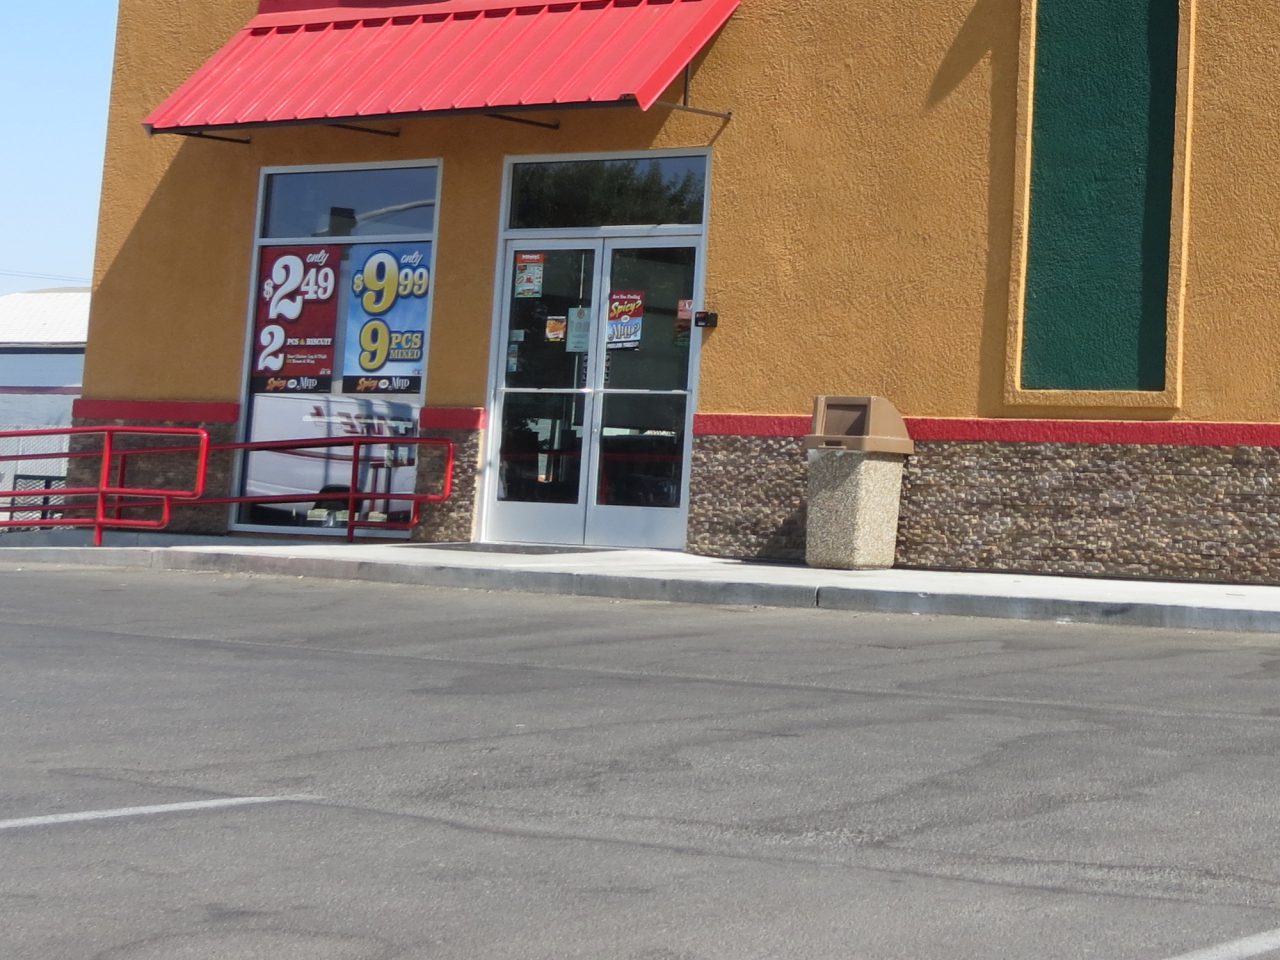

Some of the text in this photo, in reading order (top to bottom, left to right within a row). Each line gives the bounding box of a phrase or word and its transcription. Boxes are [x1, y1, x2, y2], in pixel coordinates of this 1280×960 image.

[306, 250, 329, 265] only
[400, 250, 424, 266] only
[610, 300, 642, 317] Spicy?
[258, 325, 285, 371] 2
[360, 320, 390, 370] 9
[390, 333, 422, 349] PCS
[389, 349, 421, 359] MIXED
[266, 377, 287, 390] Spicy
[356, 377, 379, 390] Spicy
